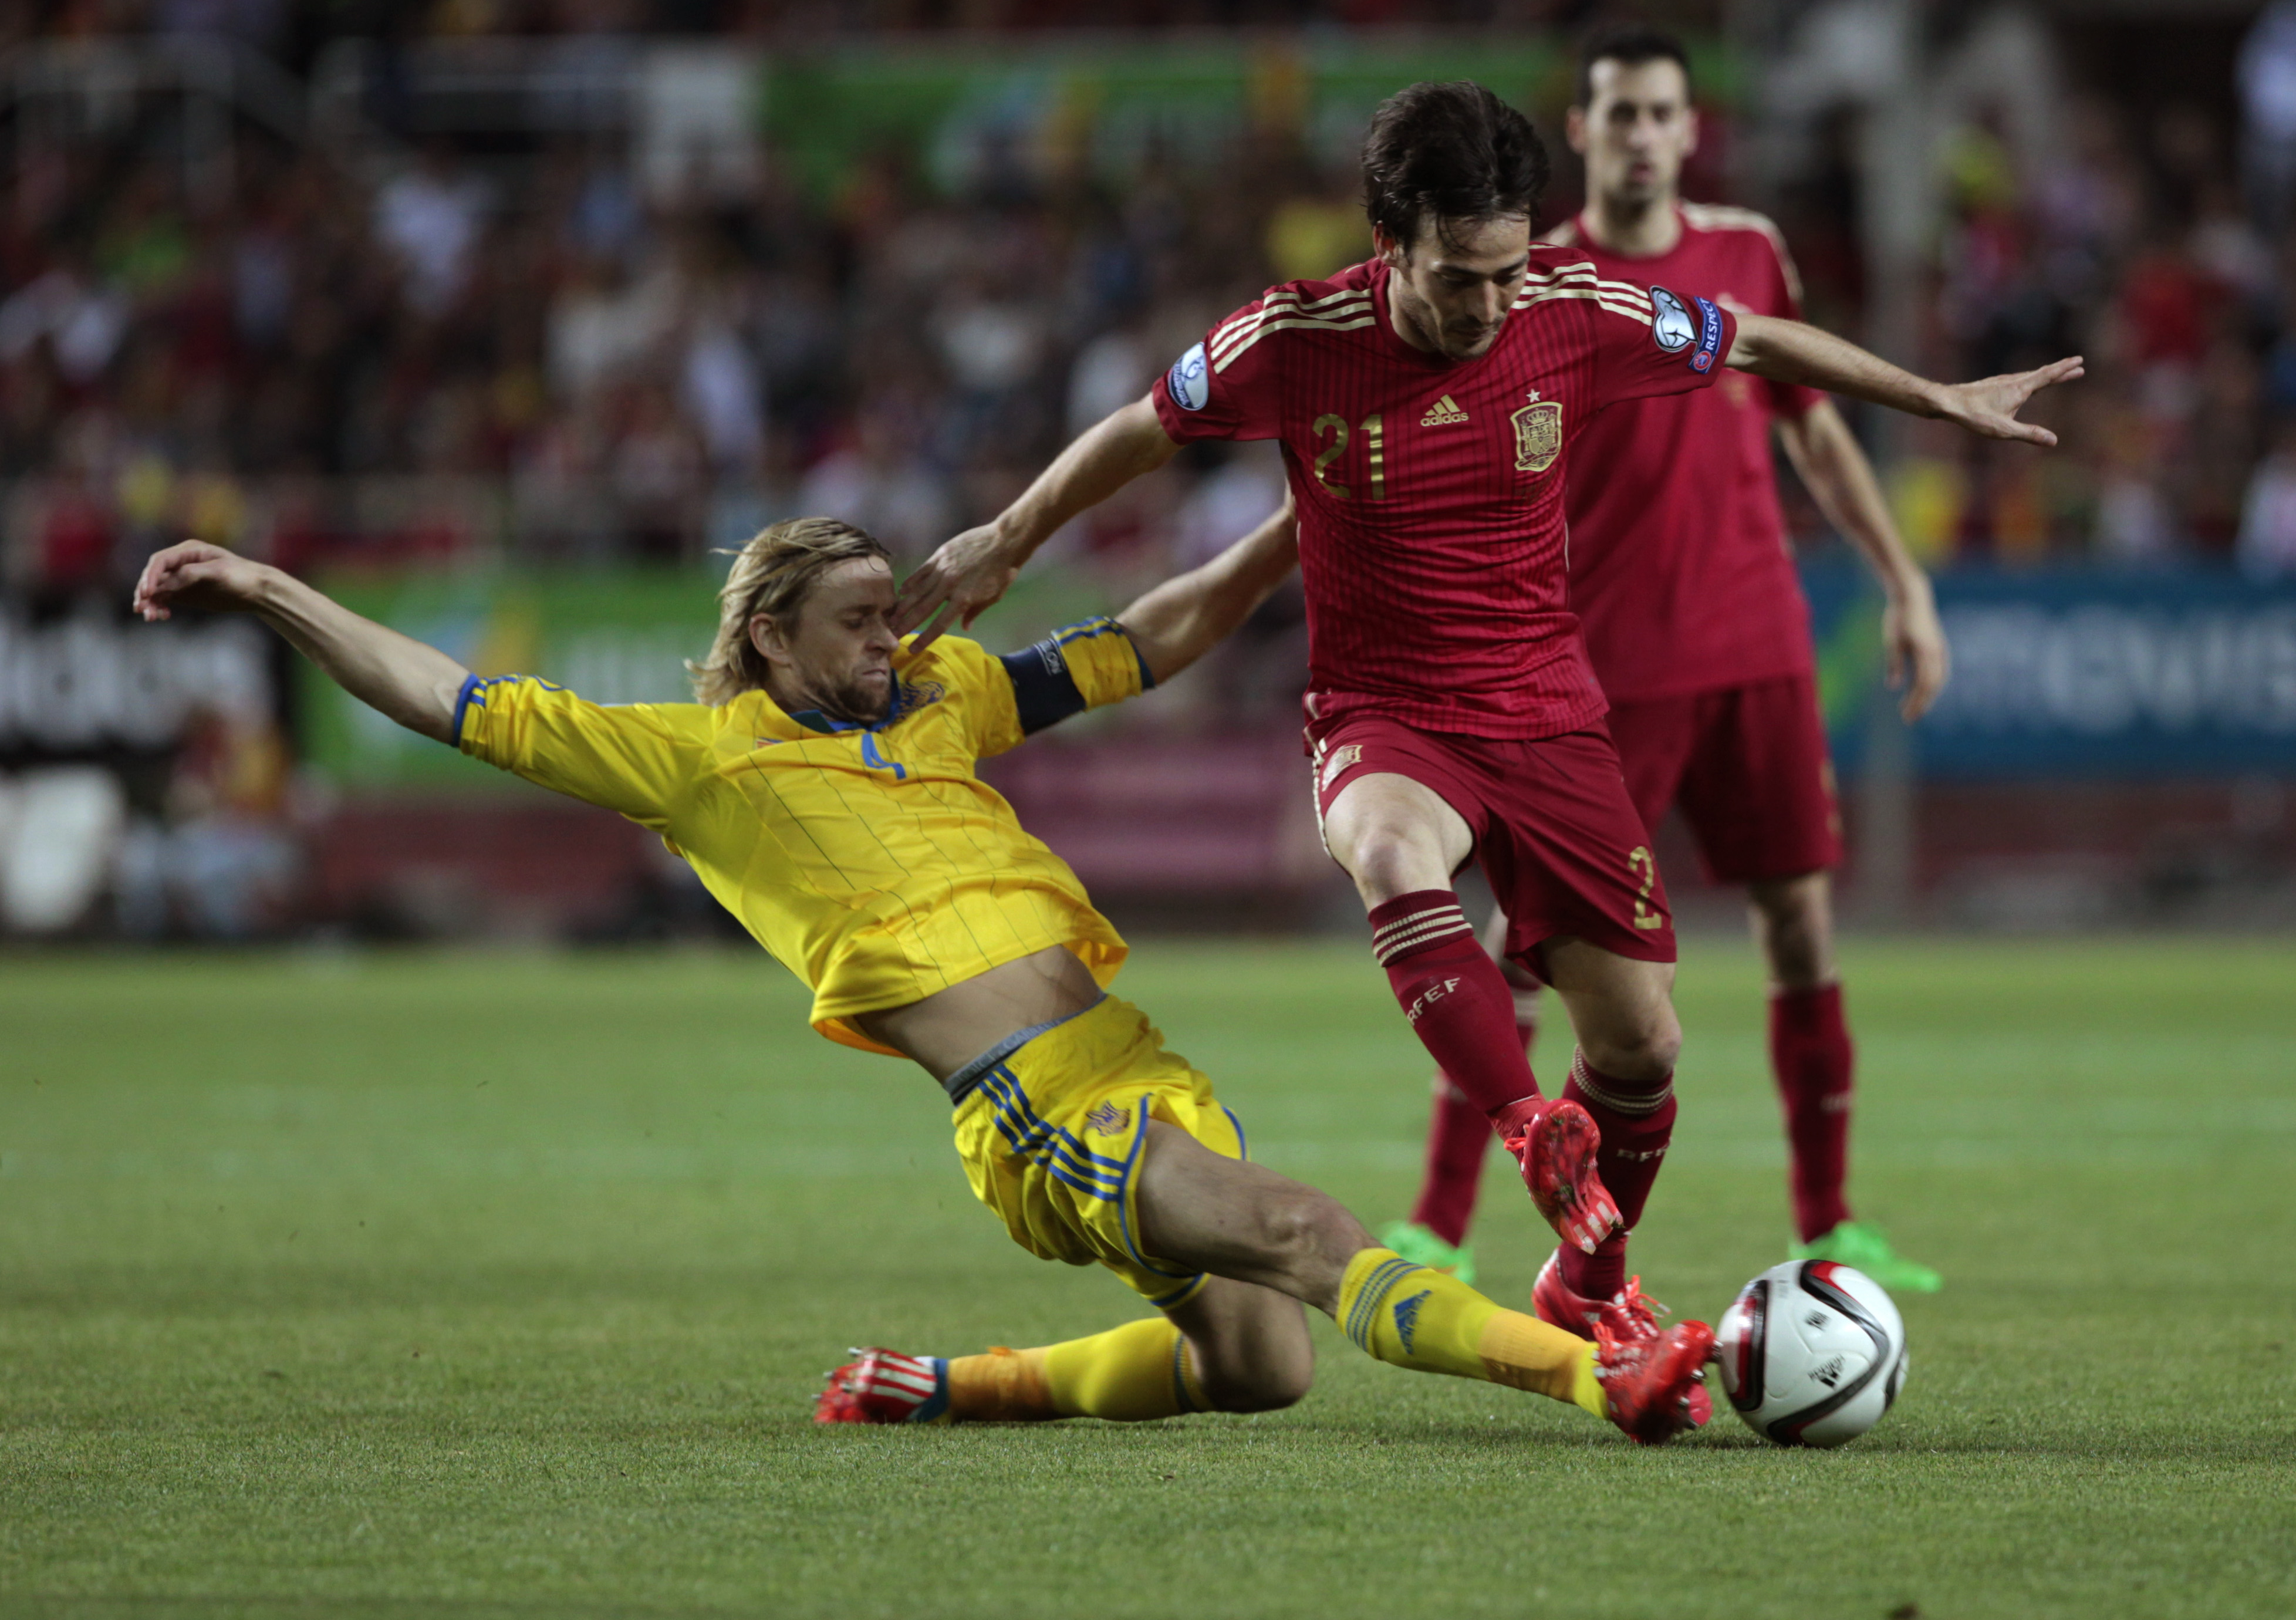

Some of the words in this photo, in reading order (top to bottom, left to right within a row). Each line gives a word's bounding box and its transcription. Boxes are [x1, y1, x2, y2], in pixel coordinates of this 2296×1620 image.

[1700, 298, 1717, 350] RESPECT
[1420, 412, 1469, 427] adidas
[1313, 413, 1384, 501] 21
[862, 733, 907, 781] 4
[1407, 977, 1460, 1026] RFEF
